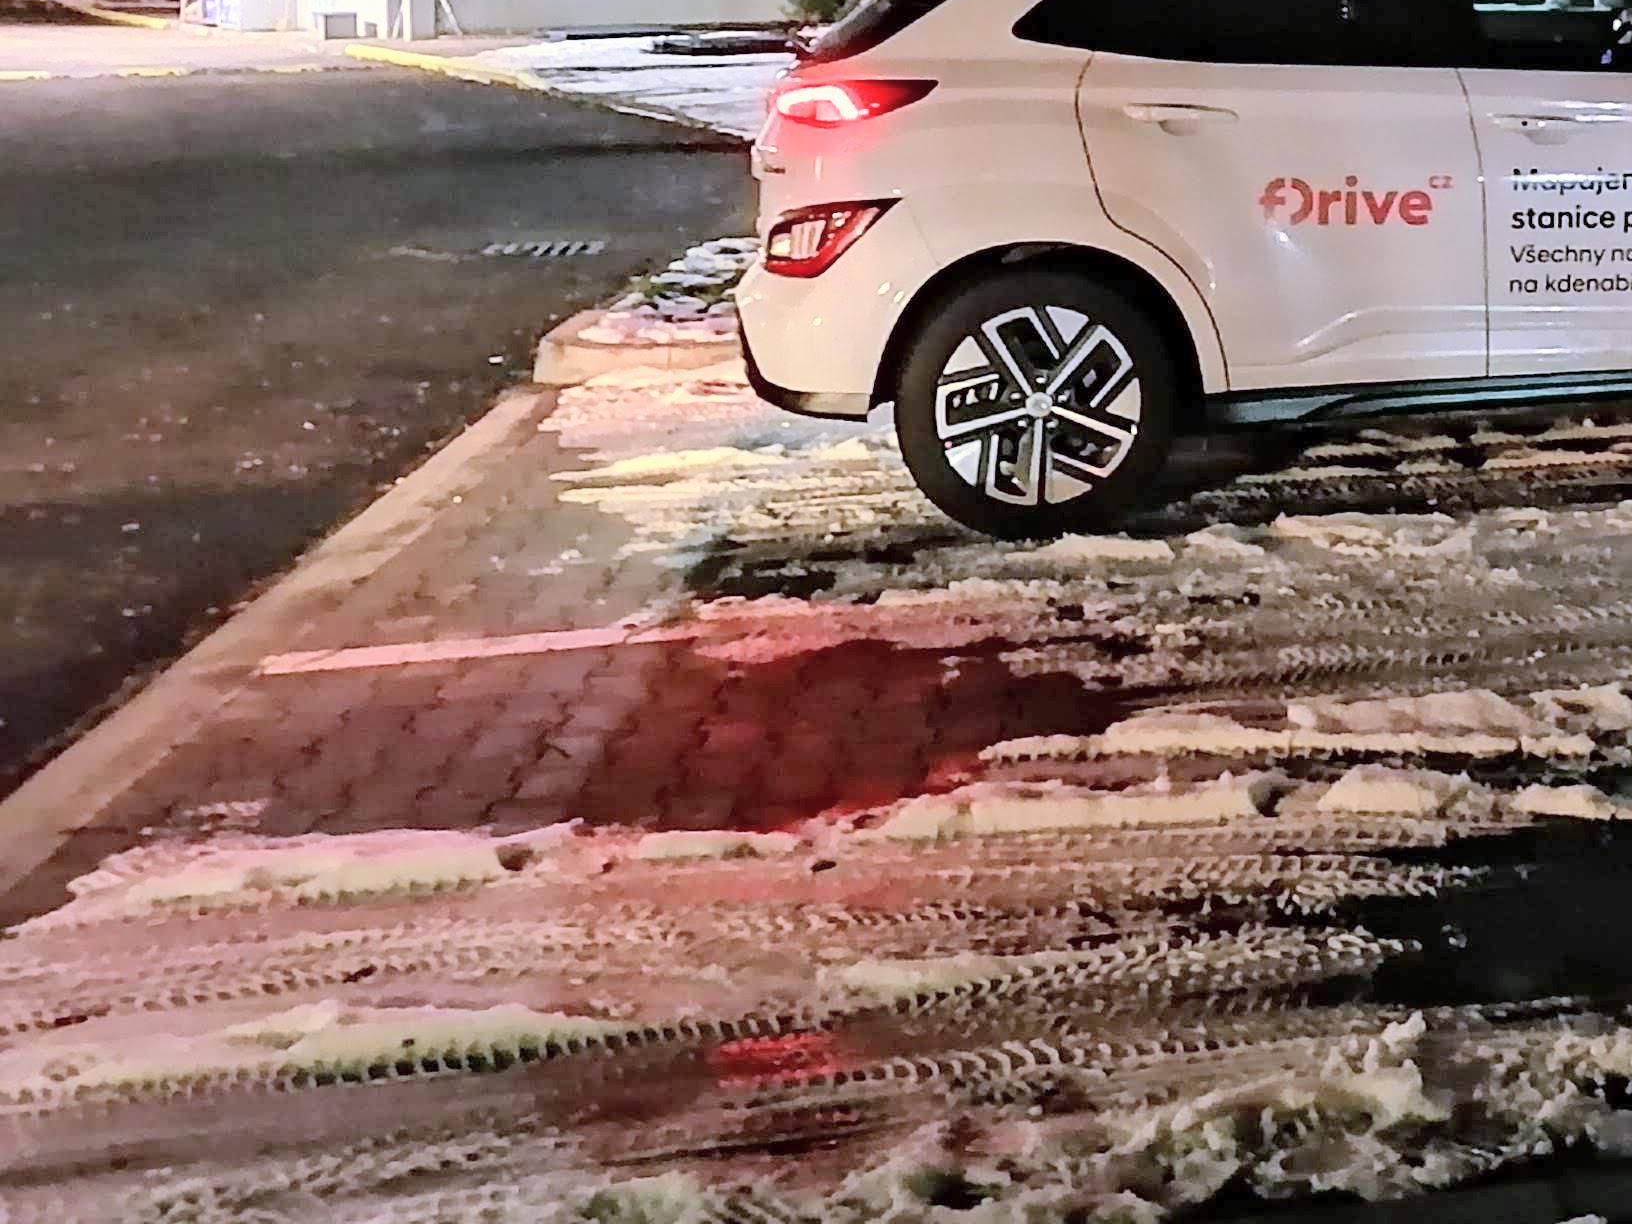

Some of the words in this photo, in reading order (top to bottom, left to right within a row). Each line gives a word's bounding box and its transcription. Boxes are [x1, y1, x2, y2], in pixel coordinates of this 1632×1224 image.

[1511, 204, 1616, 230] stanice
[1510, 243, 1606, 266] Všechny
[1509, 277, 1538, 293] na
